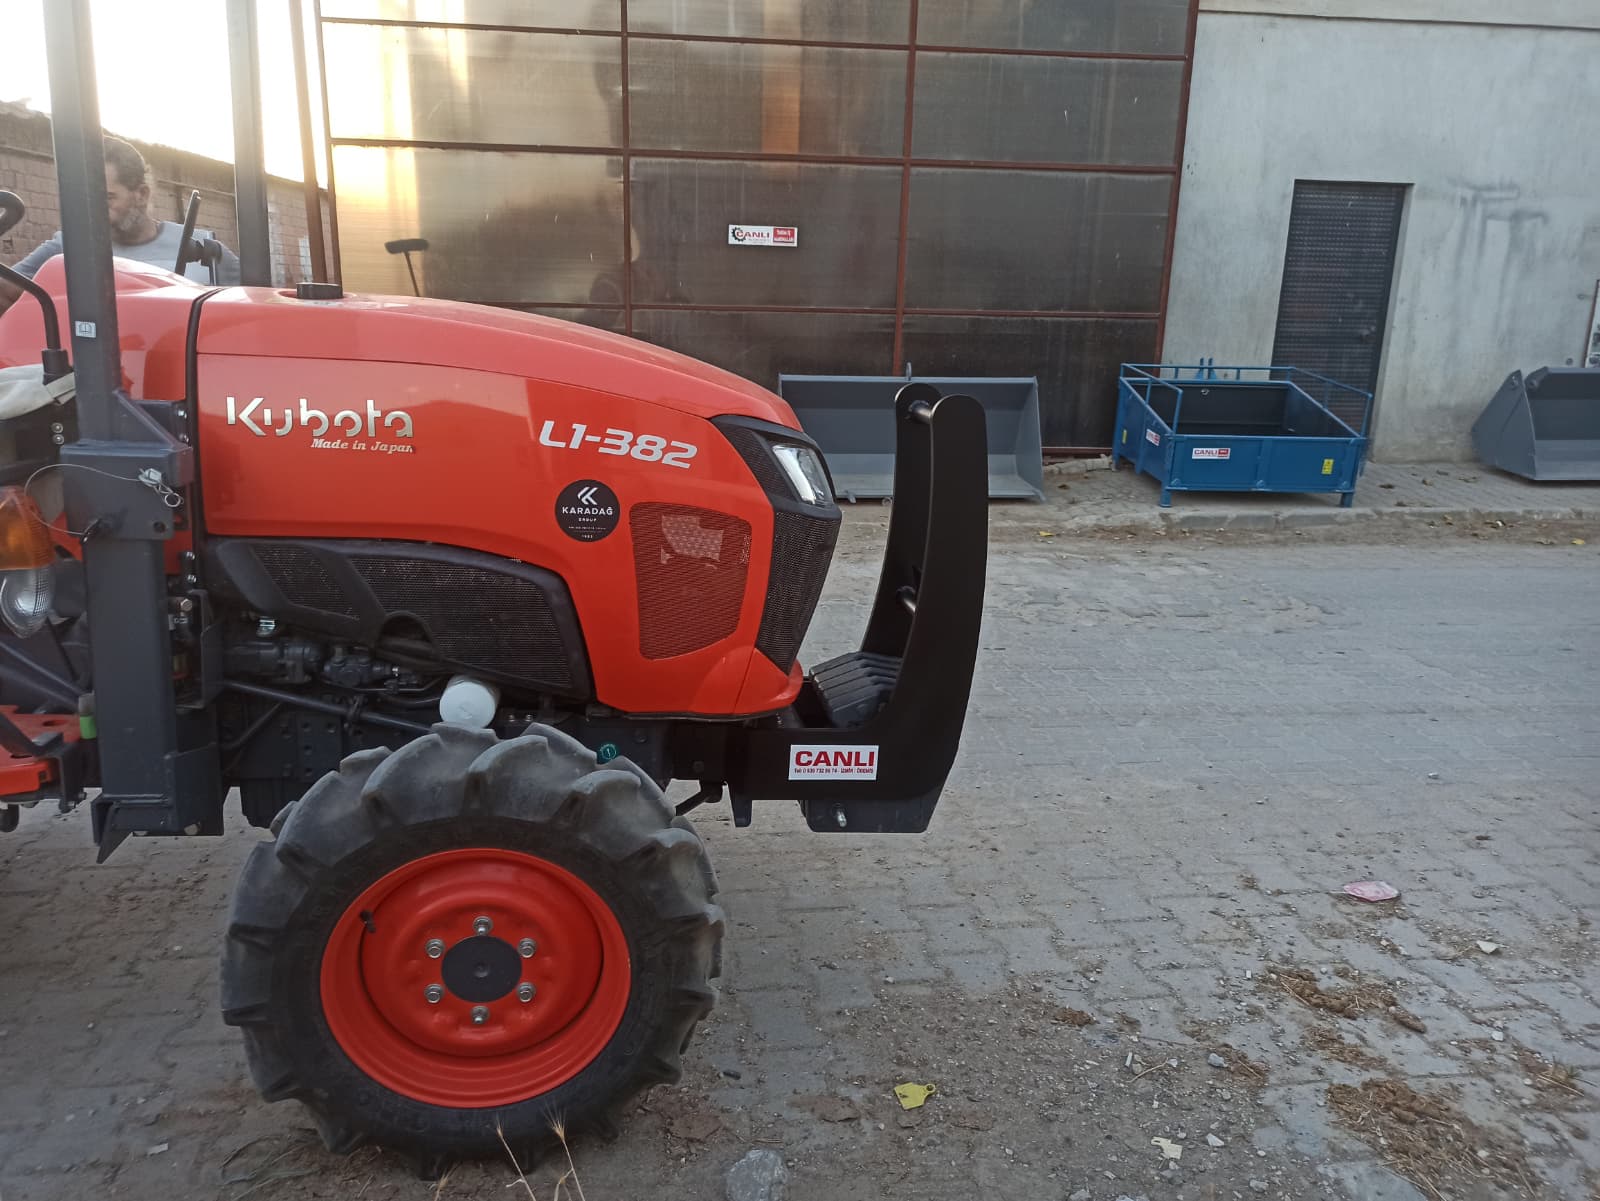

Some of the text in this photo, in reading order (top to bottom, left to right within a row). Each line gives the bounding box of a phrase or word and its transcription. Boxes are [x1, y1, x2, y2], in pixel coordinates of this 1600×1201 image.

[736, 230, 770, 238] CANLI
[226, 396, 413, 438] Kubota
[310, 438, 413, 454] Made in Japan
[538, 420, 698, 469] L1-382
[562, 506, 613, 516] KARADAĞ
[795, 751, 875, 767] CANLI
